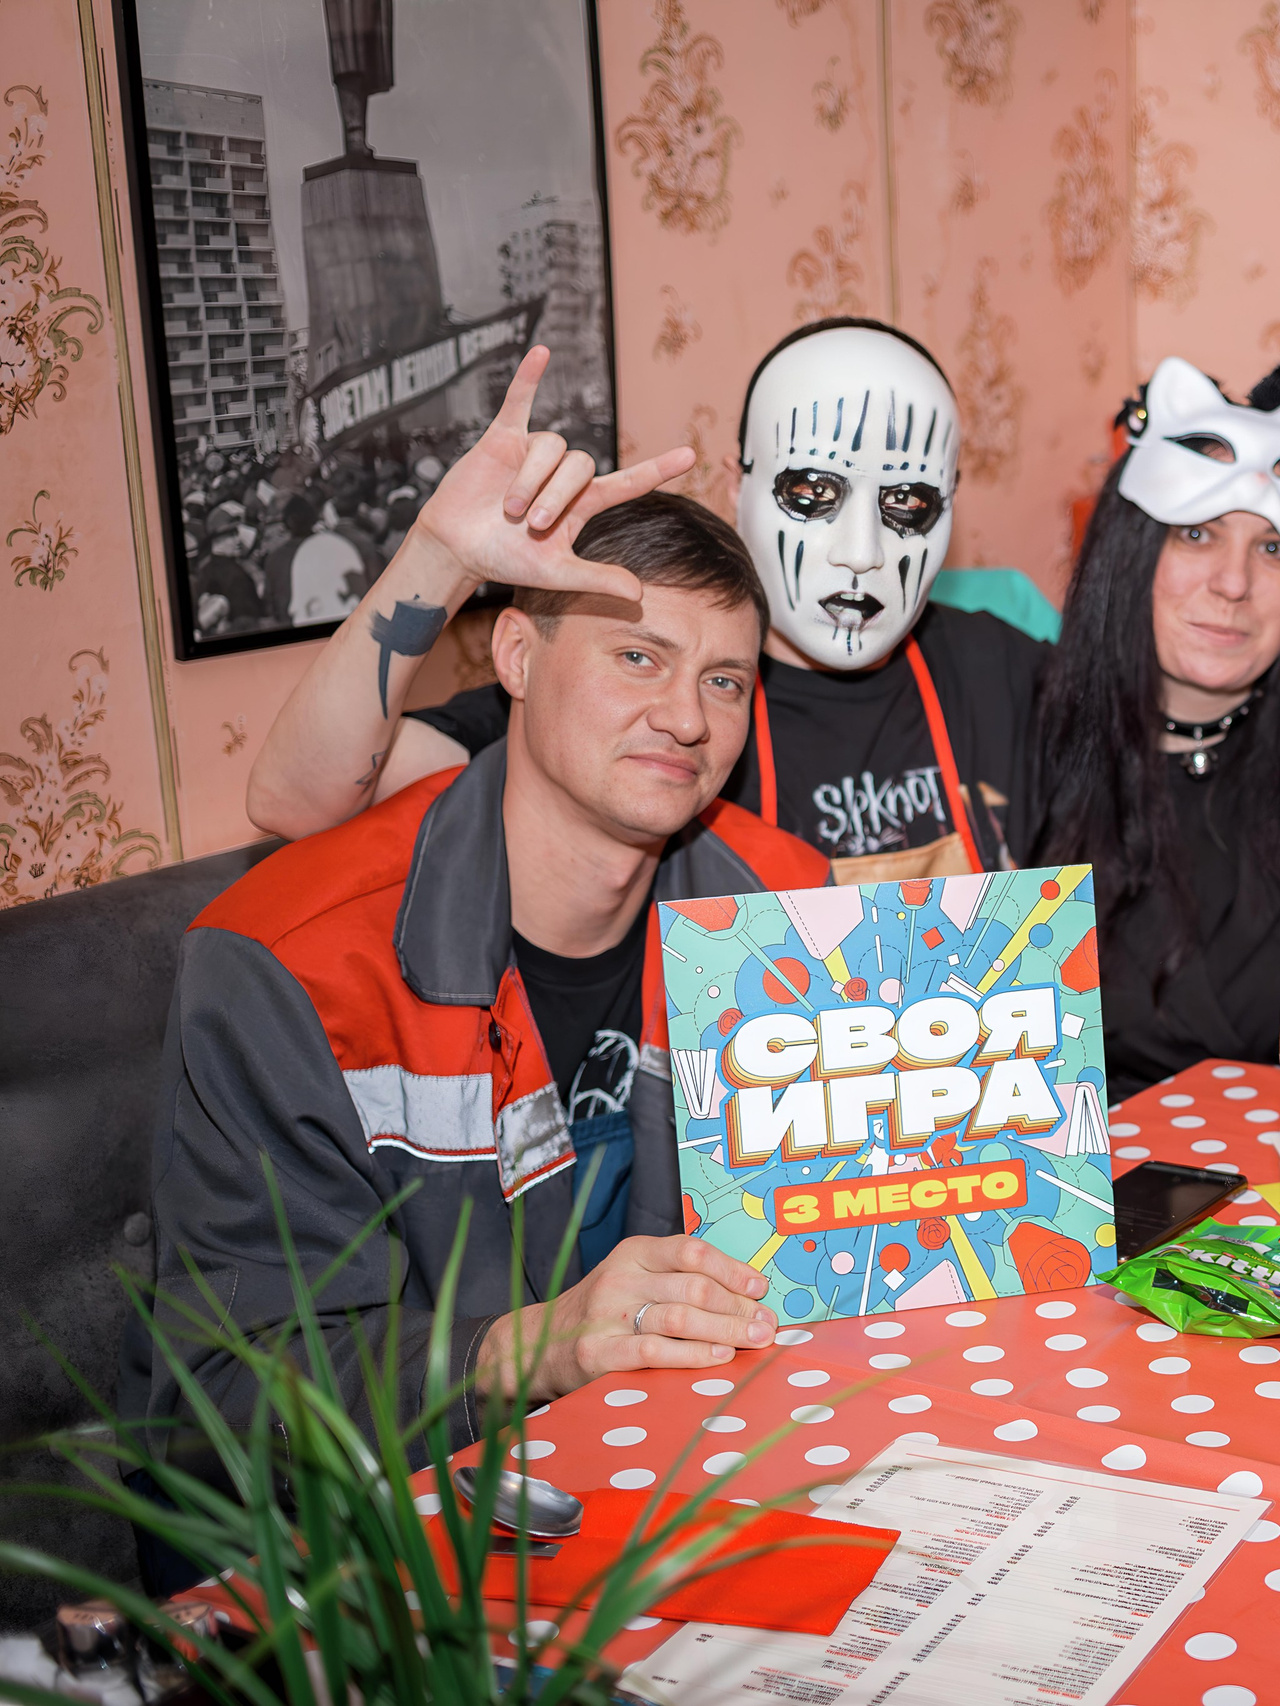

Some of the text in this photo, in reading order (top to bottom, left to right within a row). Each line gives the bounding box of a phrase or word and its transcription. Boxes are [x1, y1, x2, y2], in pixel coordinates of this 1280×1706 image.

[729, 987, 1058, 1082] СВОЯ
[731, 1057, 1063, 1161] ИГРА
[782, 1171, 1020, 1224] 3 МЕСТО
